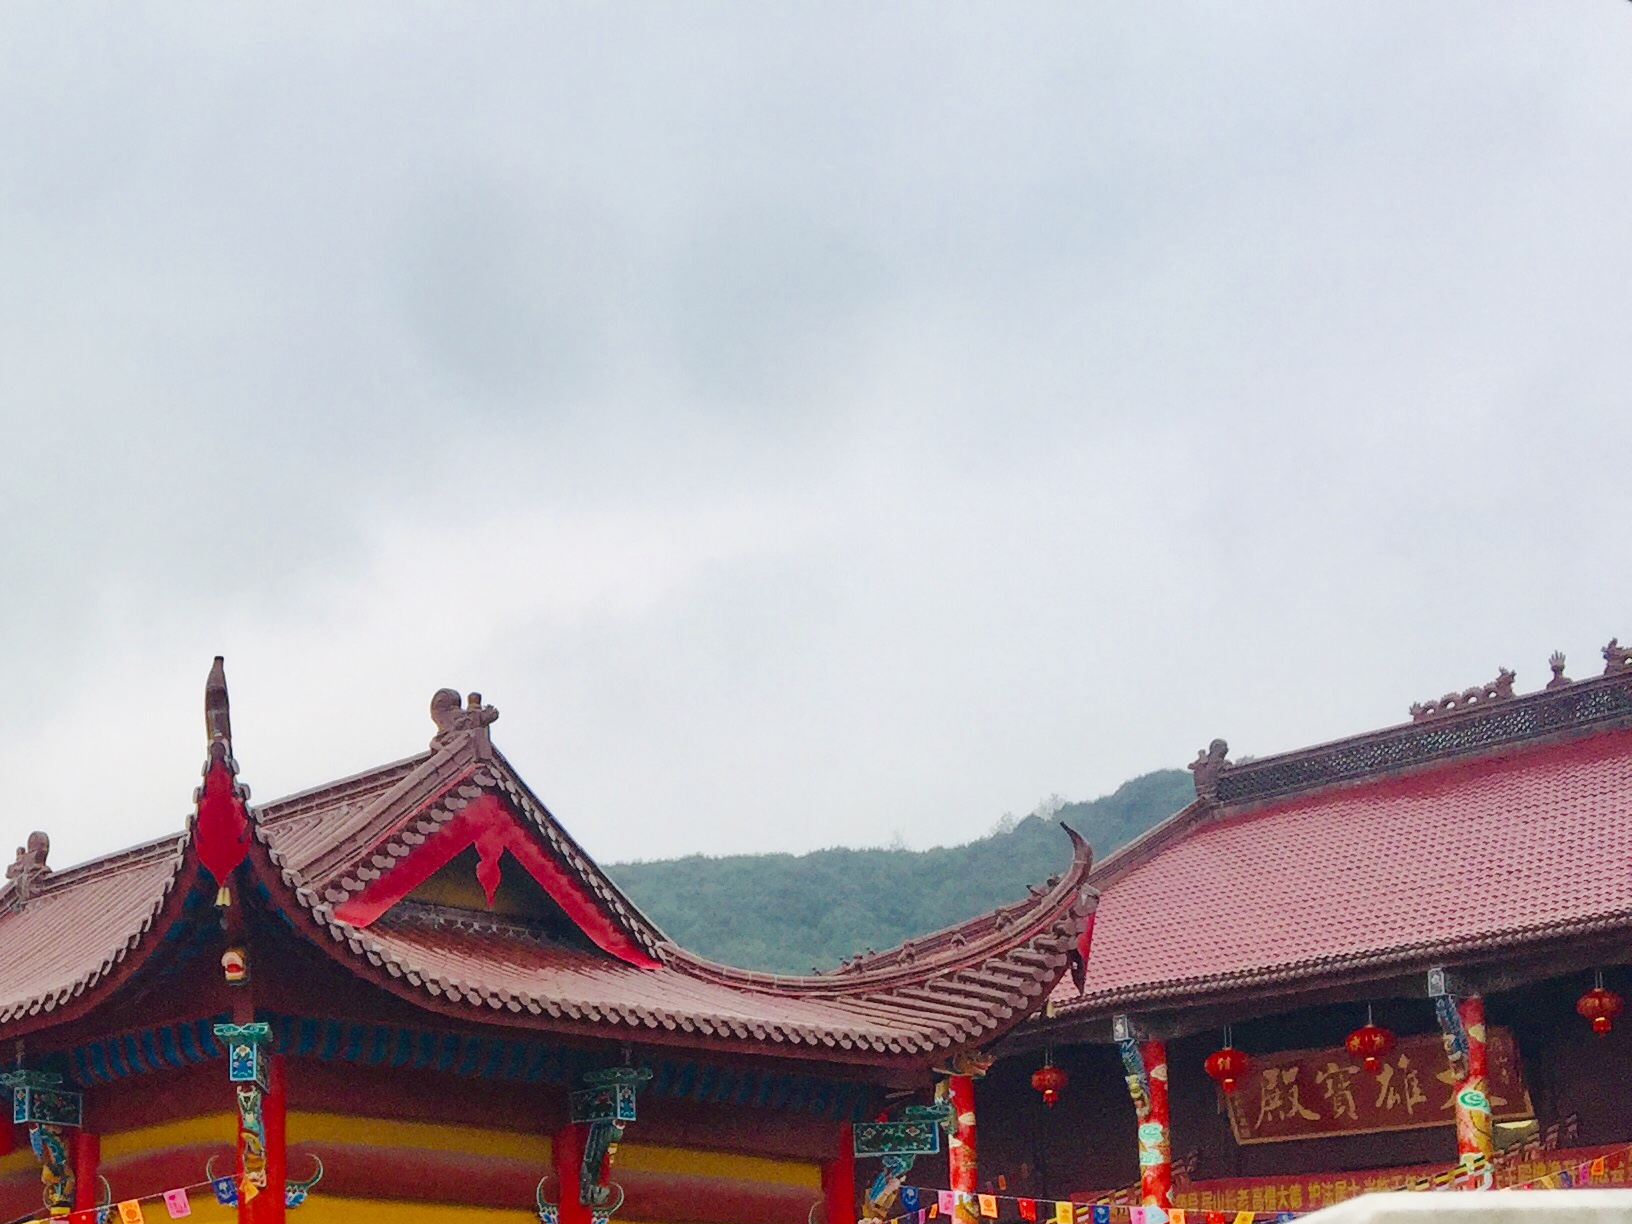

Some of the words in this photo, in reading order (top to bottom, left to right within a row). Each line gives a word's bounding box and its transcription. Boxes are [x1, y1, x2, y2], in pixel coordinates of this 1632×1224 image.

[1201, 1183, 1303, 1211] 山长老高僧大德
